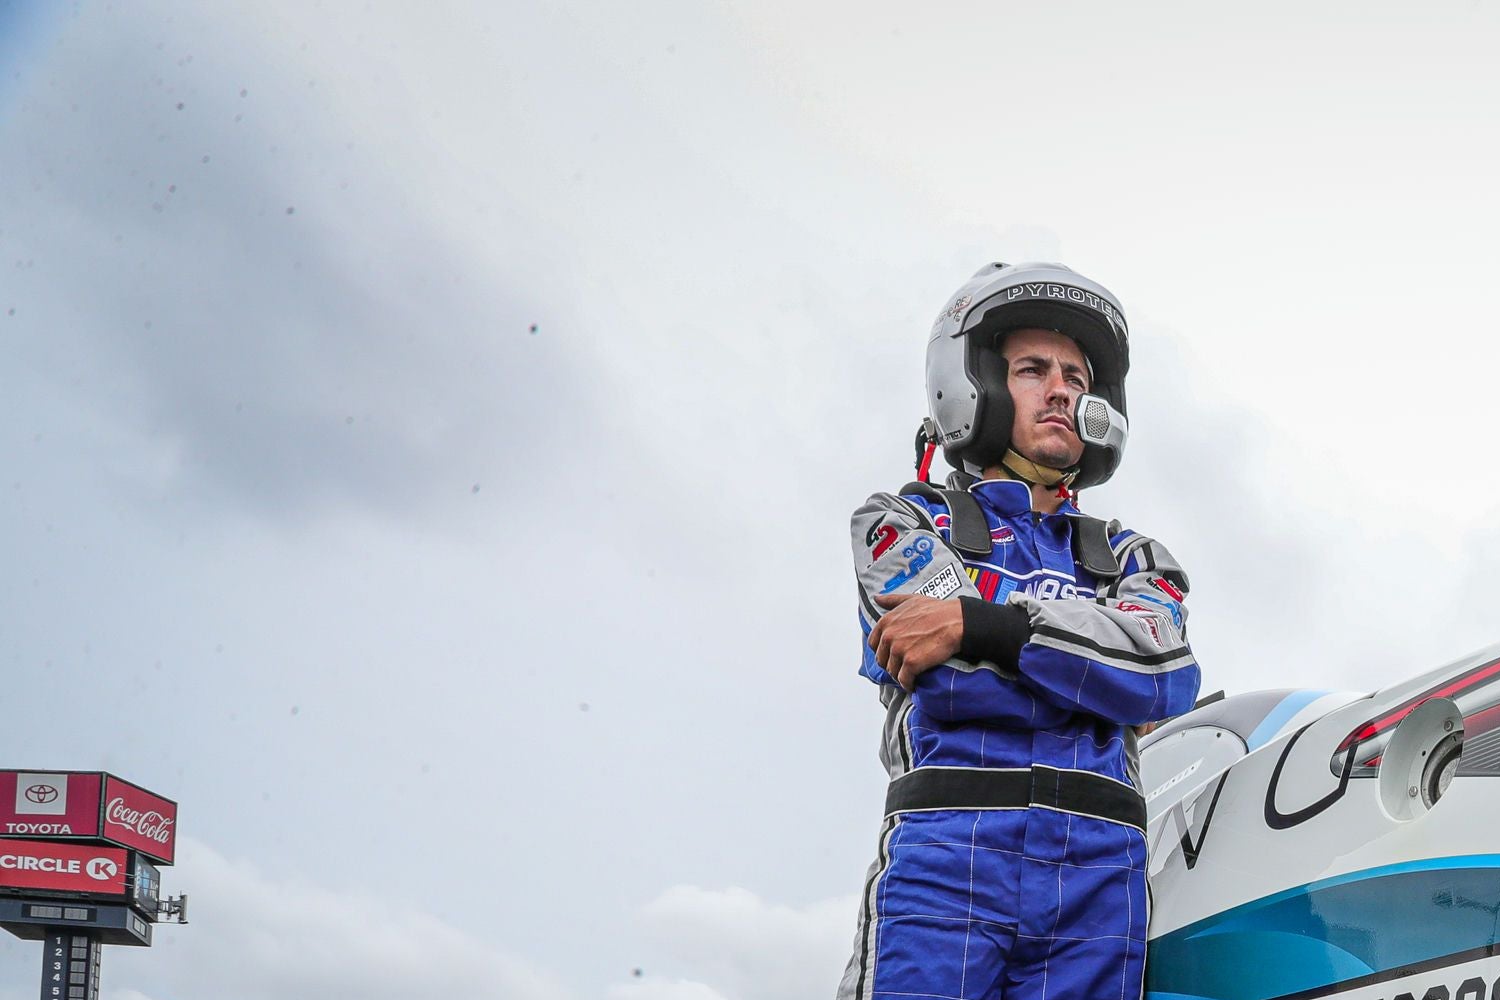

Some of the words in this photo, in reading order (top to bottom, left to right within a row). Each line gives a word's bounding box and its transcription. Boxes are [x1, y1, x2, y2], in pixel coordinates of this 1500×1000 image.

[105, 797, 175, 844] Coca-Cola
[6, 823, 72, 835] TOYOTA
[0, 855, 81, 874] CIRCLE
[91, 859, 116, 880] K
[55, 936, 61, 945] 1
[55, 948, 62, 957] 2
[53, 961, 61, 970] 3
[53, 973, 61, 982] 4
[52, 986, 60, 995] 5
